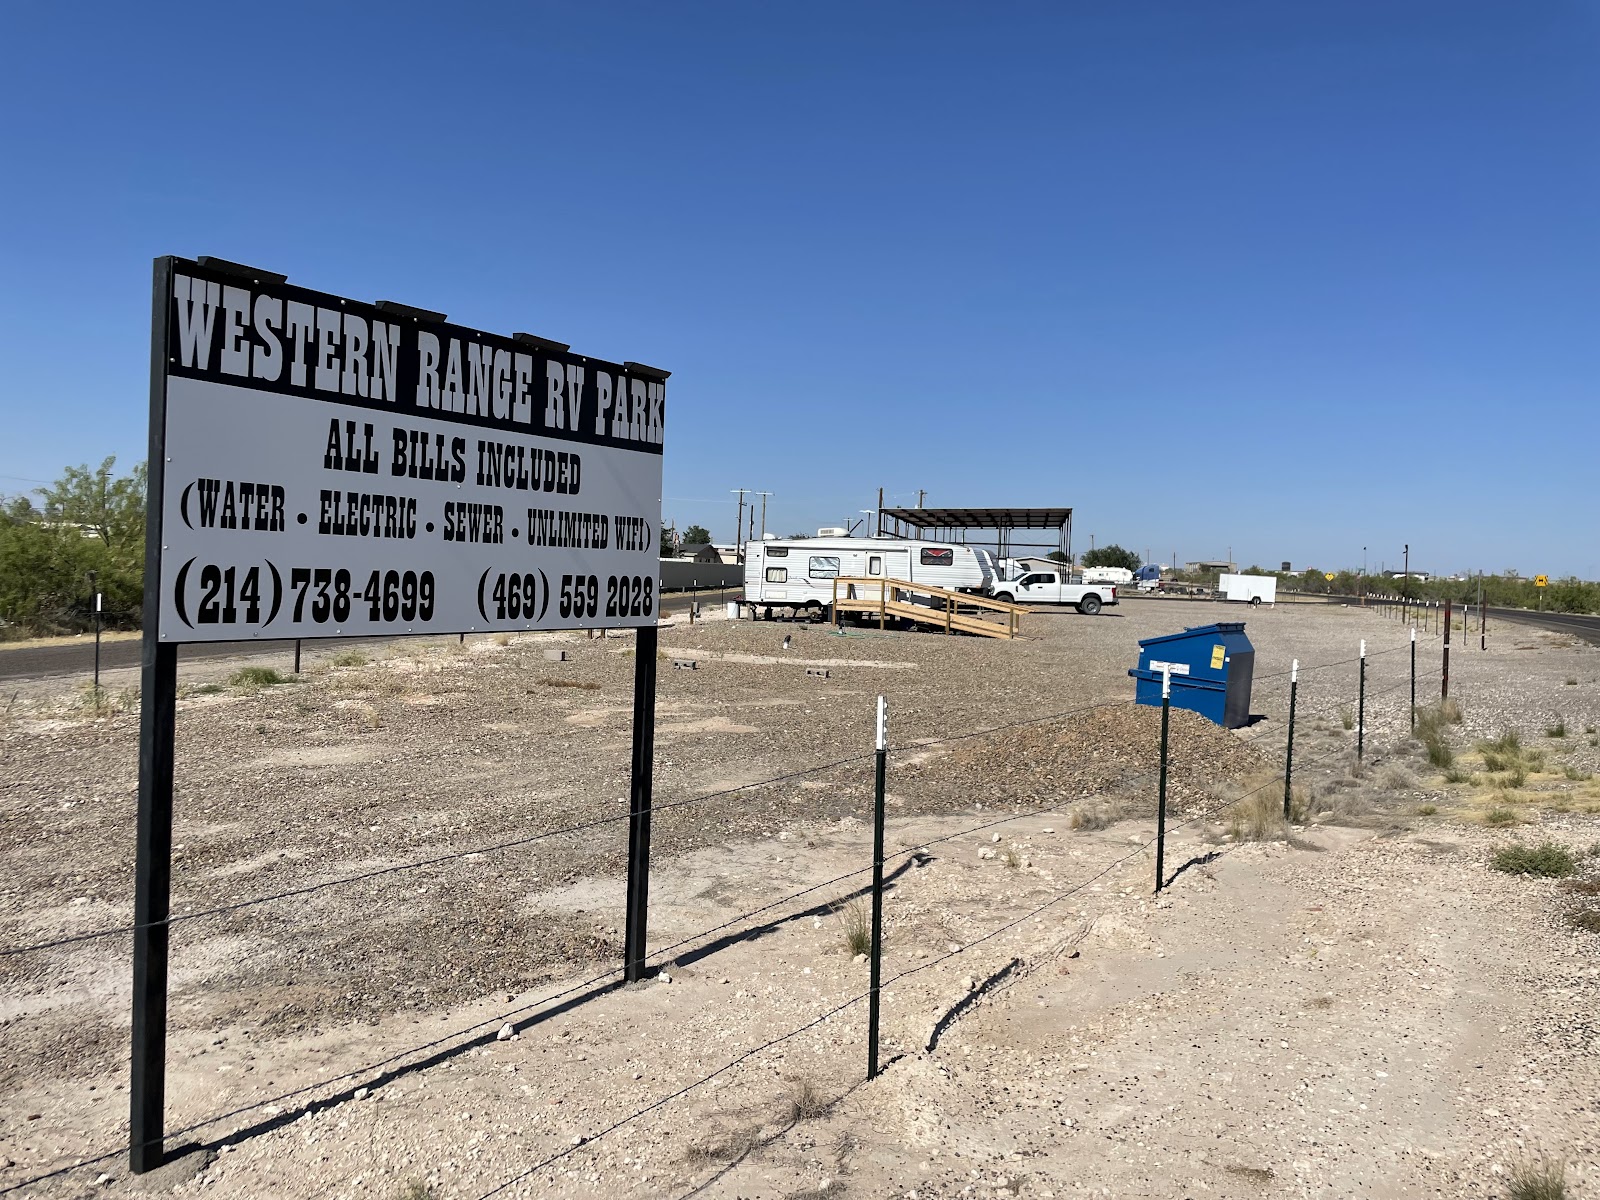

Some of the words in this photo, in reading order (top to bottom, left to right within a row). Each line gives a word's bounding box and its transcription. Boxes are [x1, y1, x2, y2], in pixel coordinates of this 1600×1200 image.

[174, 273, 400, 402] WESTERN
[416, 330, 533, 424] RANGE
[544, 359, 585, 431] RV
[595, 371, 664, 444] PARK
[324, 418, 379, 474] ALL
[391, 427, 466, 483] BILLS
[476, 440, 581, 495] INCLUDED
[180, 478, 285, 532] (WATER
[318, 489, 417, 539] ELECTRIC
[443, 501, 503, 544] SEWER
[527, 508, 608, 549] UNLIMITED
[614, 515, 651, 553] WIFI)
[477, 566, 550, 623] (469)
[559, 574, 599, 618] 559
[605, 575, 653, 618] 2028
